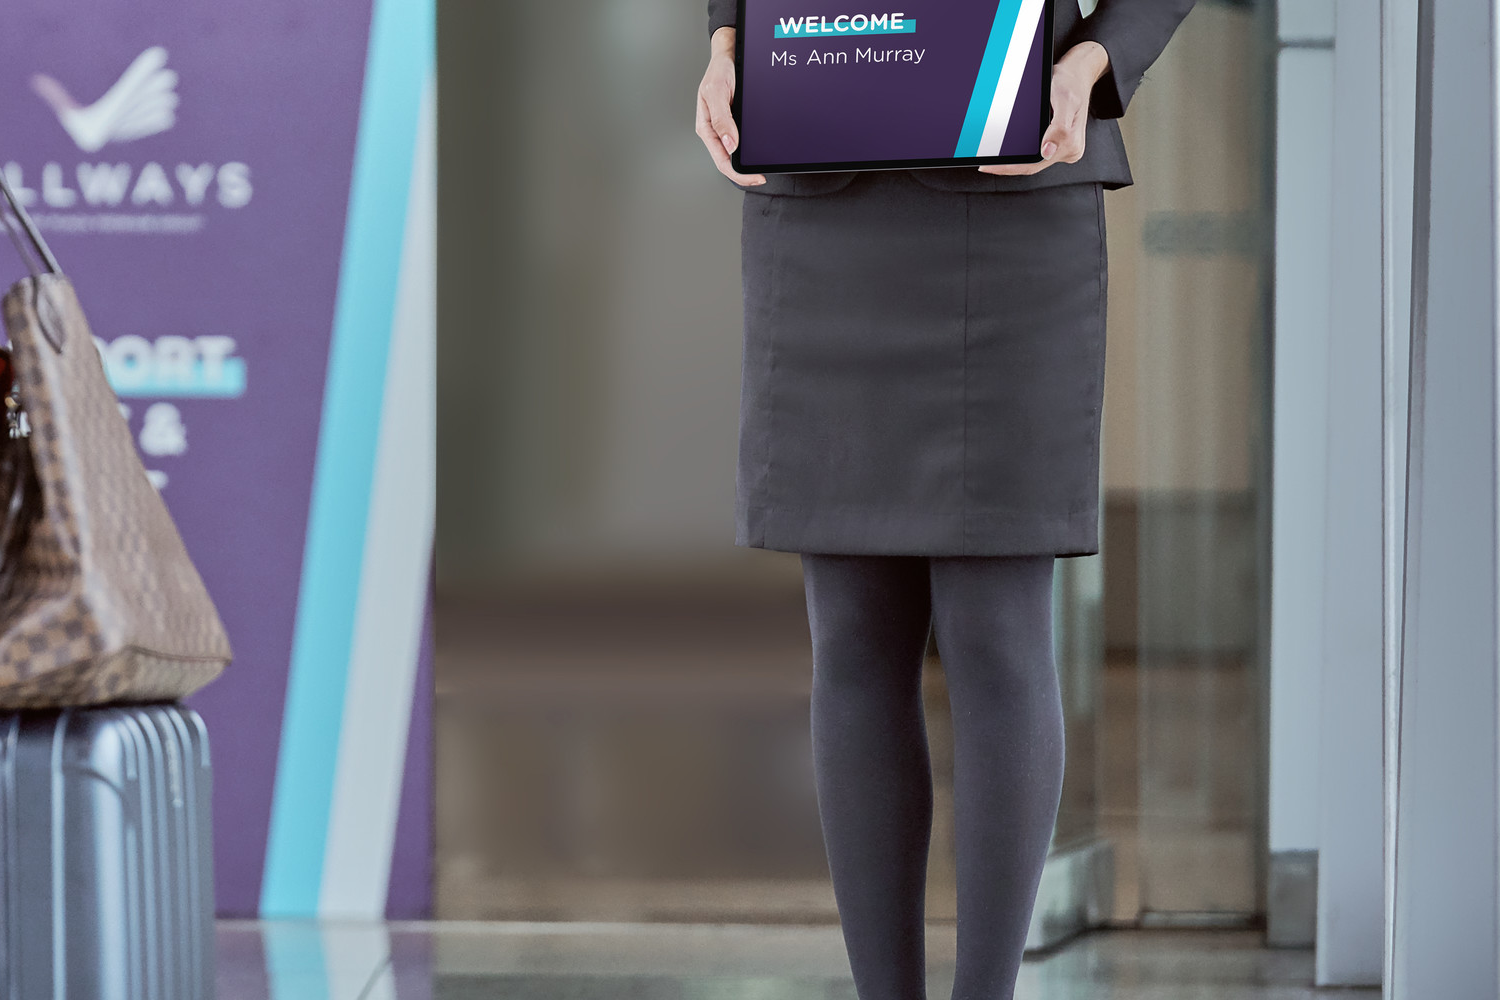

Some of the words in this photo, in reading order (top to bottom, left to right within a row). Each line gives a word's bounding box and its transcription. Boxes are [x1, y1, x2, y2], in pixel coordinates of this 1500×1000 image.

[779, 12, 905, 34] WELCOME
[771, 50, 797, 66] Ms
[807, 49, 847, 65] Ann
[856, 47, 925, 65] Murray
